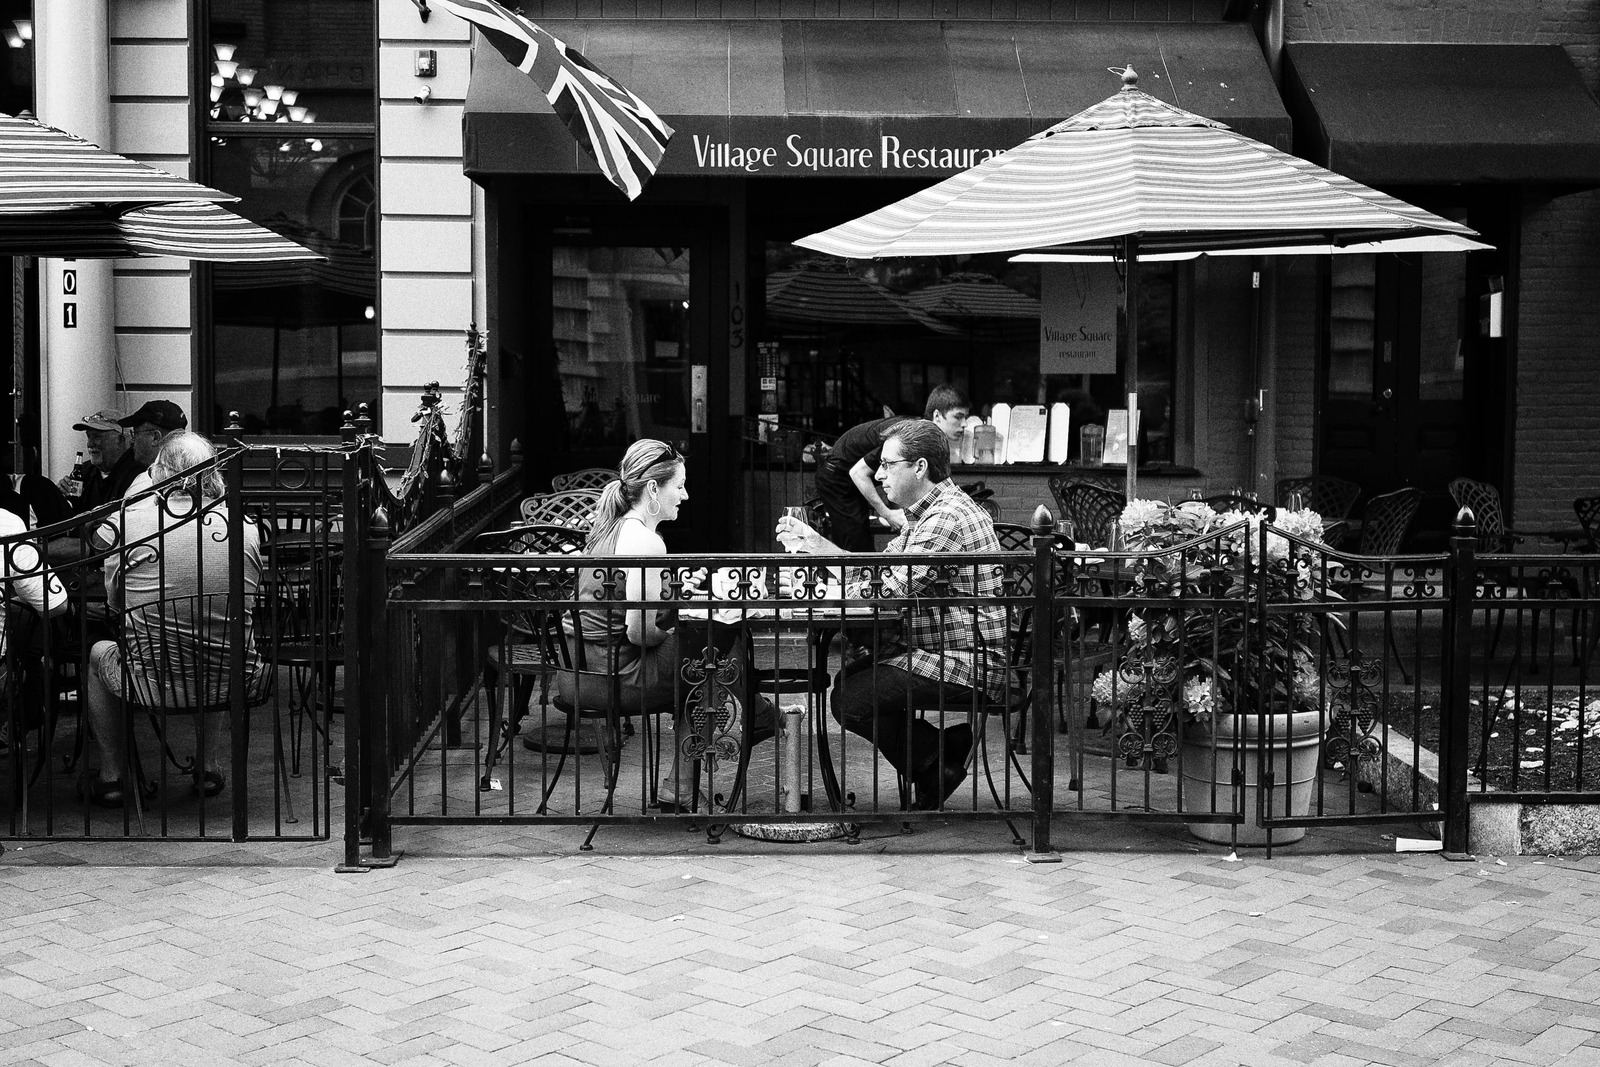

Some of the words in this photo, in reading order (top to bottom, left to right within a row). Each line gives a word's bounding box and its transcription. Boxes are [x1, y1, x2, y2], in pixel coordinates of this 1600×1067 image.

[692, 134, 778, 173] Village
[786, 134, 873, 171] Square
[881, 135, 1007, 169] Restaura
[64, 271, 76, 327] 01
[731, 281, 743, 349] 103
[1045, 326, 1078, 342] Village
[1080, 325, 1113, 342] Square
